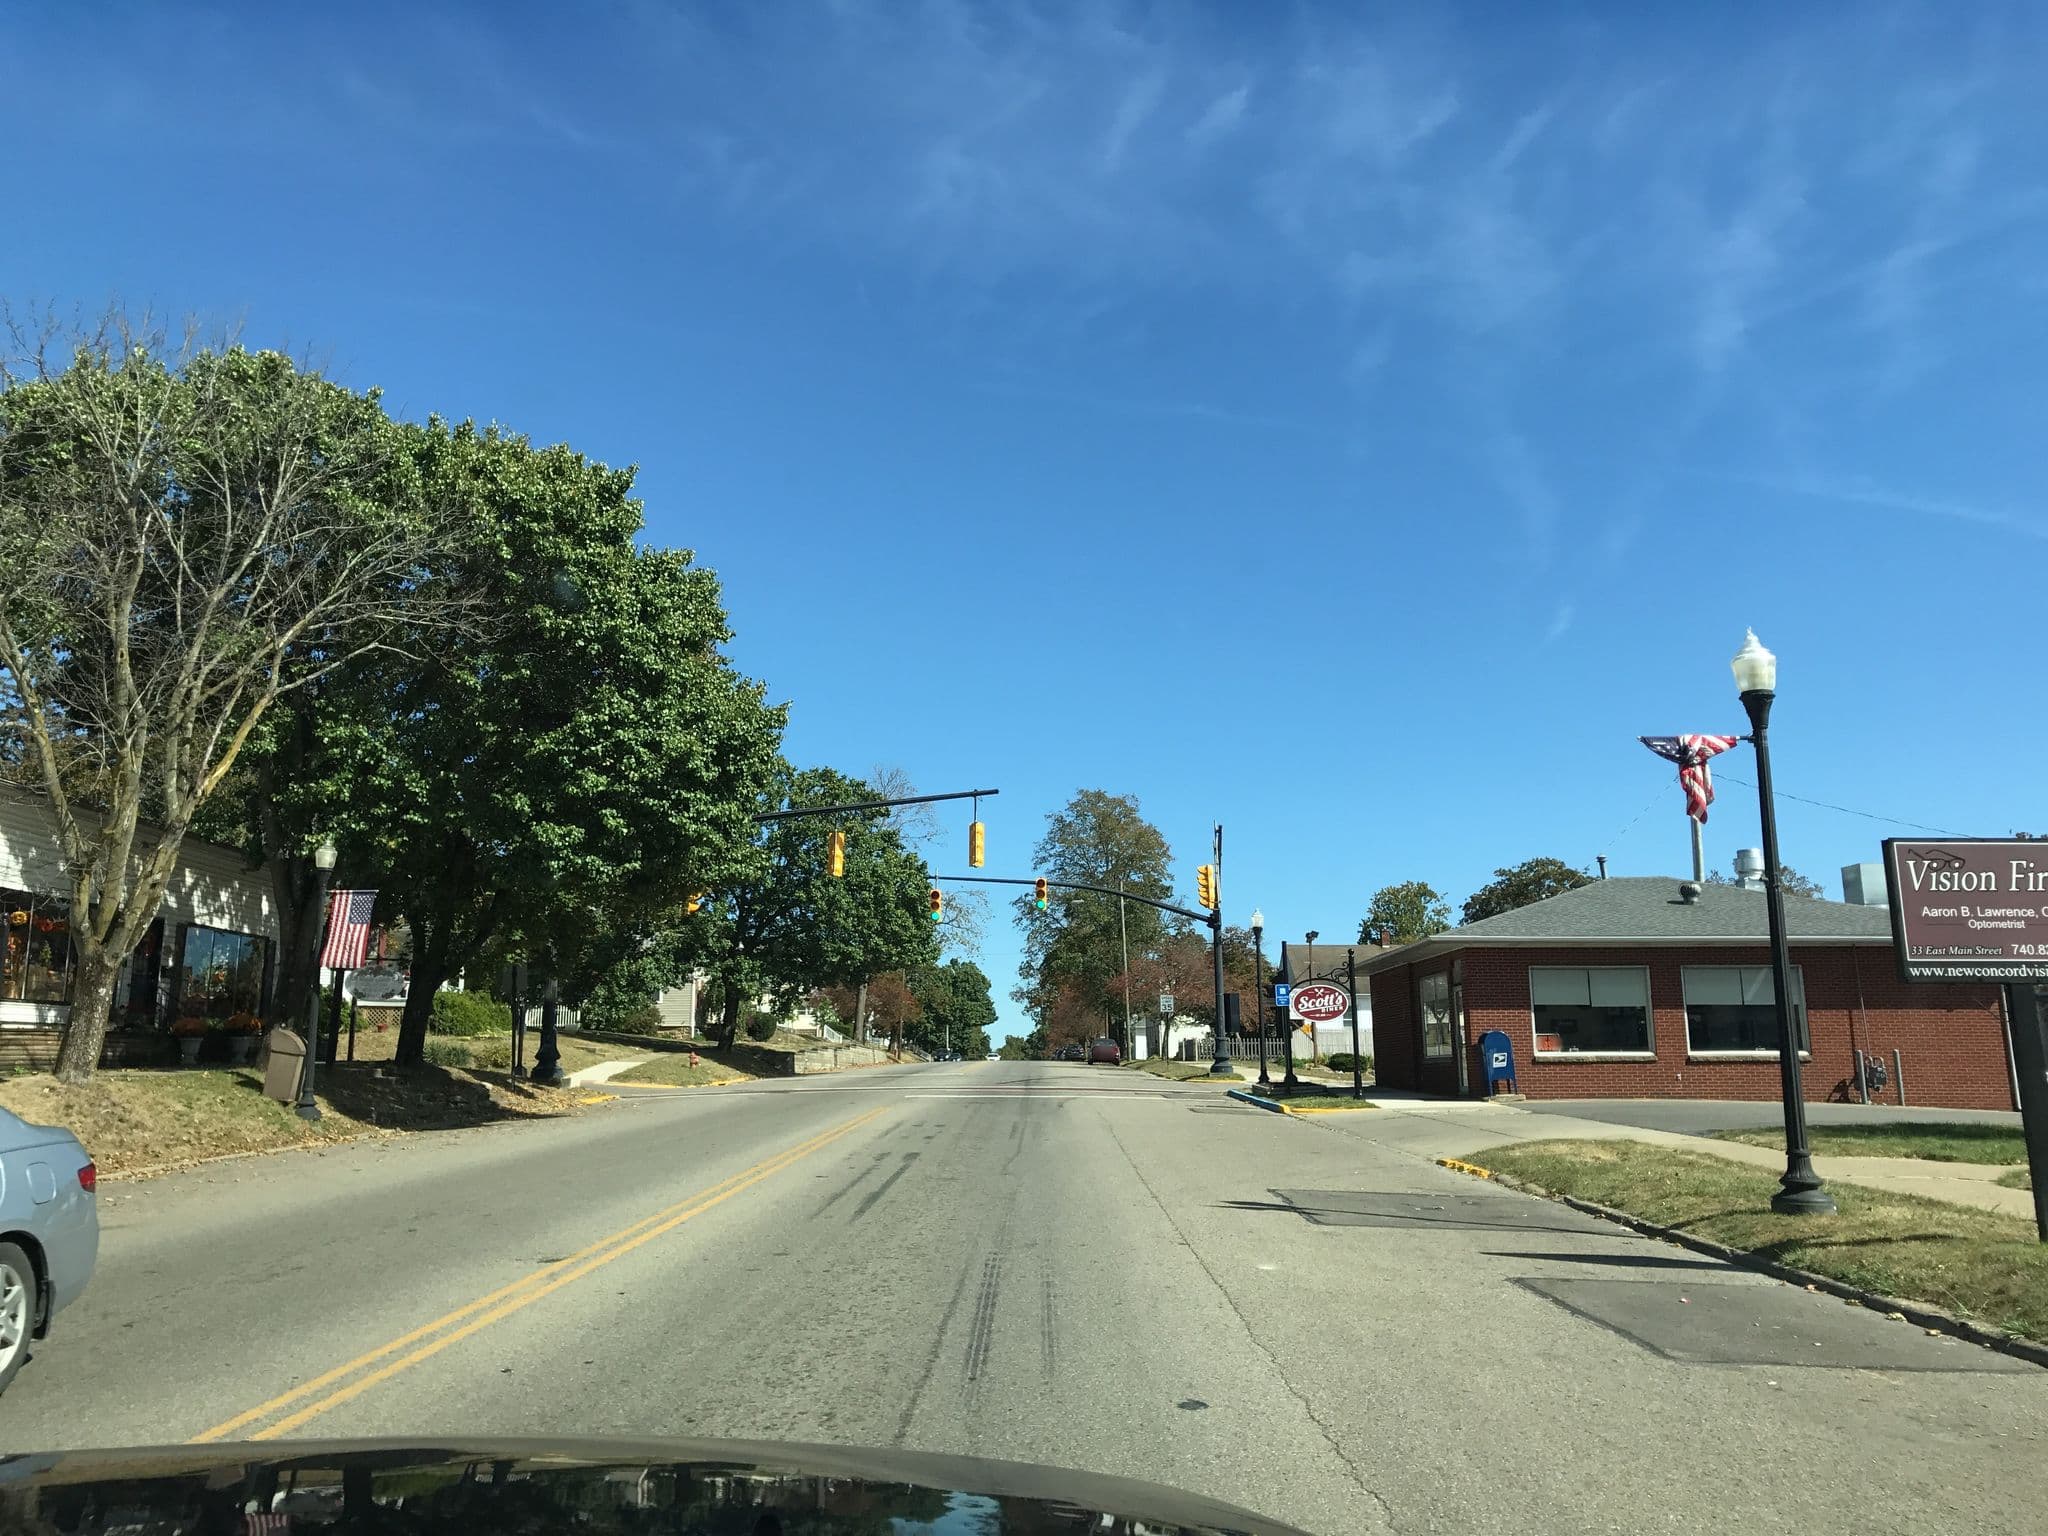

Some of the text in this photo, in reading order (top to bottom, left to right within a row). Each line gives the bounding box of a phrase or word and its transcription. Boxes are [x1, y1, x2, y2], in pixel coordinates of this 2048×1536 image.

[1906, 860, 1997, 891] Vision
[1922, 906, 1958, 918] Aaron
[1961, 906, 1974, 918] B.
[1977, 906, 2039, 919] Lawrence,
[1967, 919, 2026, 930] Optometrist
[1911, 946, 2003, 956] 33 East Main Street
[1298, 992, 1343, 1009] Scott's
